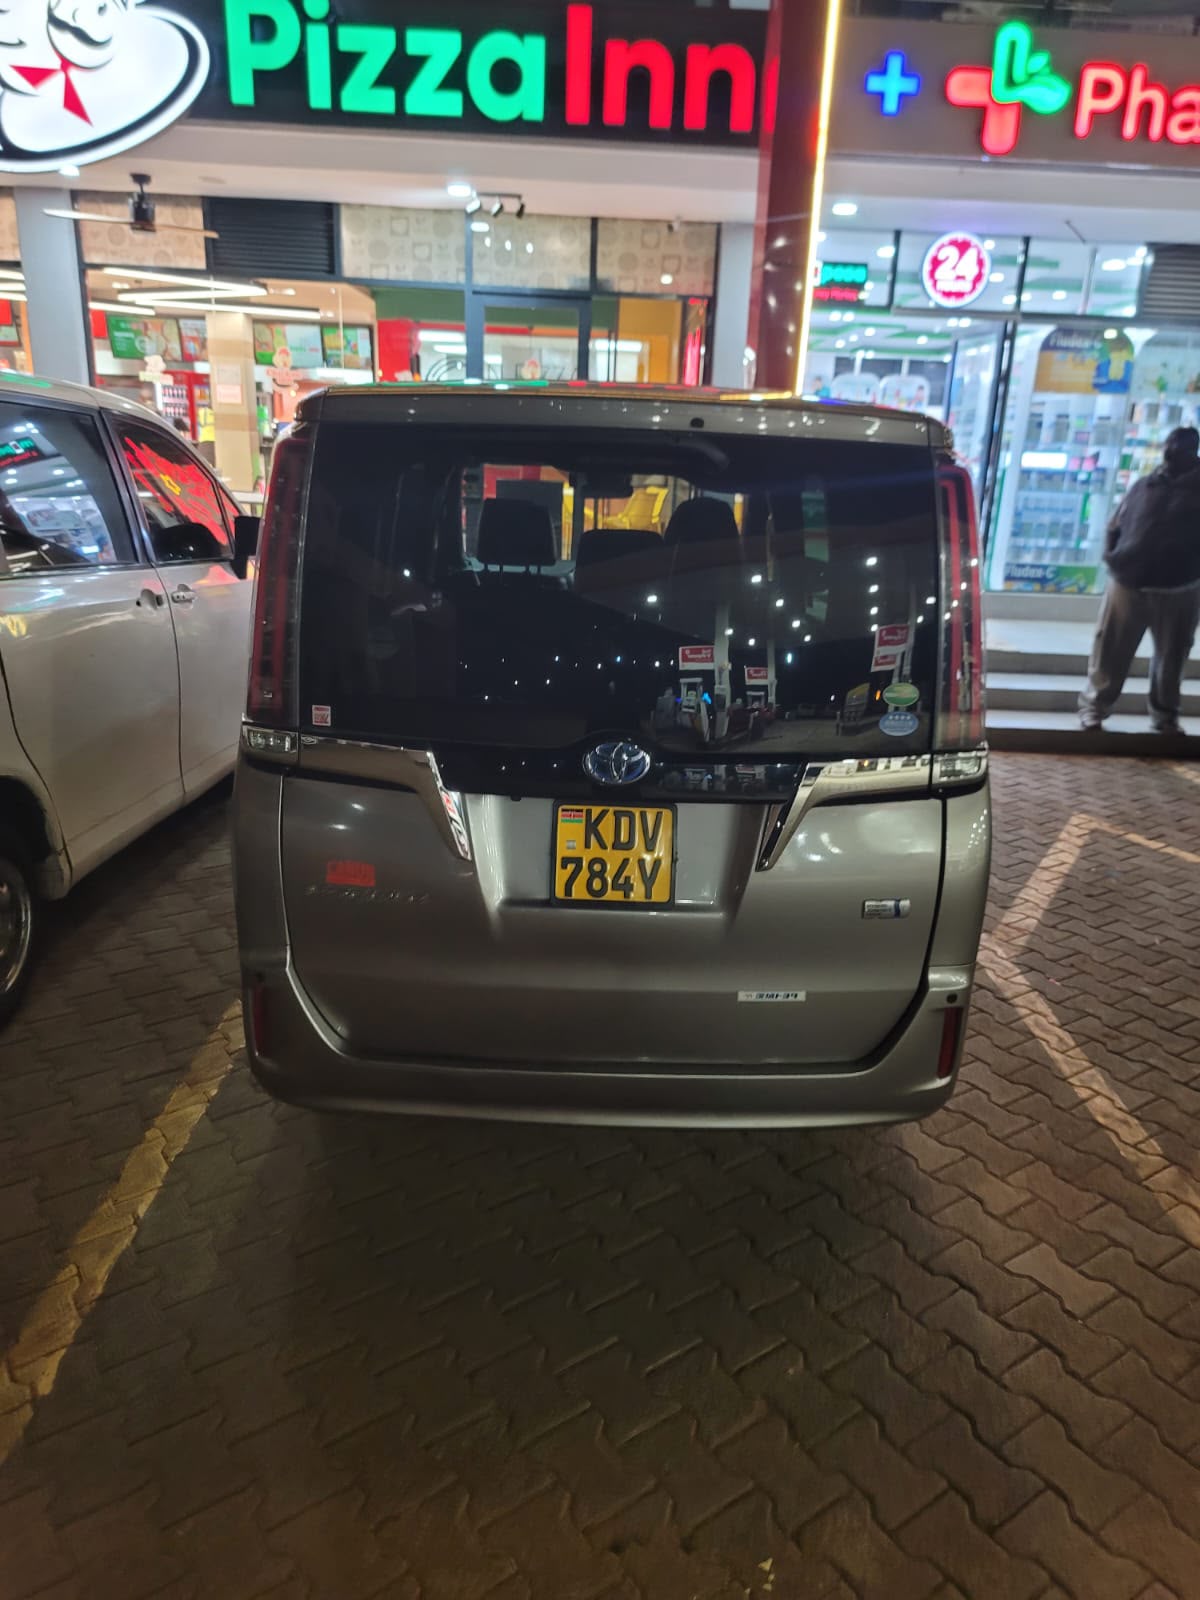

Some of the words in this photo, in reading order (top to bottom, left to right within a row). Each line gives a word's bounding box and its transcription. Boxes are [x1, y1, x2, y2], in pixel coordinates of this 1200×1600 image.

[224, 0, 546, 121] Pizza
[565, 3, 756, 133] Inn
[1074, 61, 1200, 144] Pha
[934, 244, 979, 280] 24
[584, 808, 663, 852] KDV
[560, 856, 662, 899] 784Y
